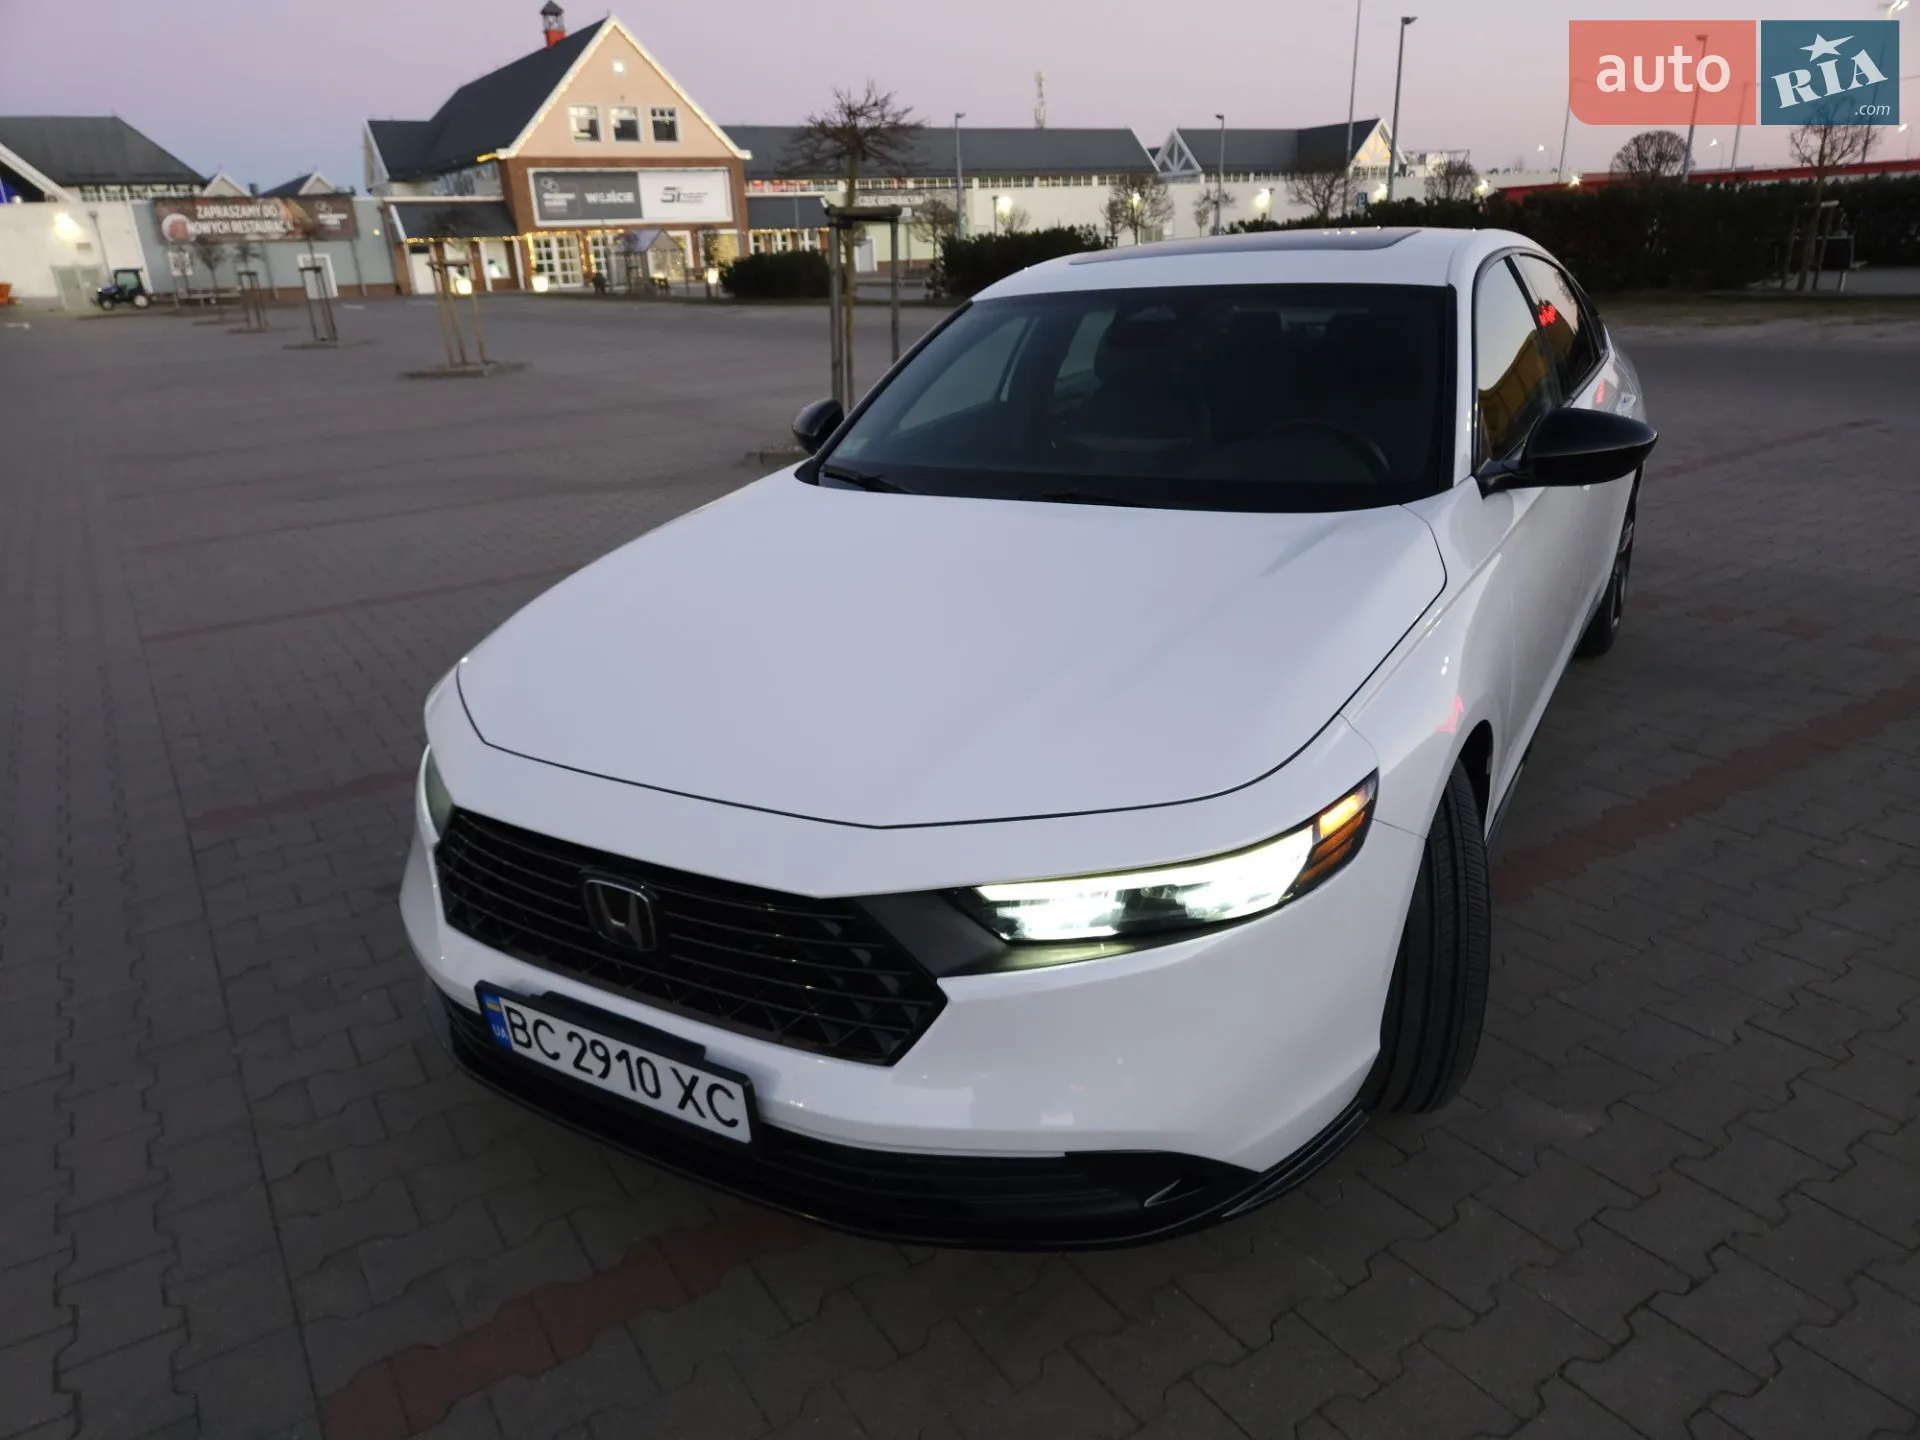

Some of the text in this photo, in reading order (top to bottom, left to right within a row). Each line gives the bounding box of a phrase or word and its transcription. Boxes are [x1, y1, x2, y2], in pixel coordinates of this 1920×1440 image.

[195, 203, 279, 219] ZAPRASZAMY DO
[187, 220, 230, 235] NOWYCH
[491, 1023, 509, 1040] UA
[503, 1005, 739, 1128] BC 2910 XC
